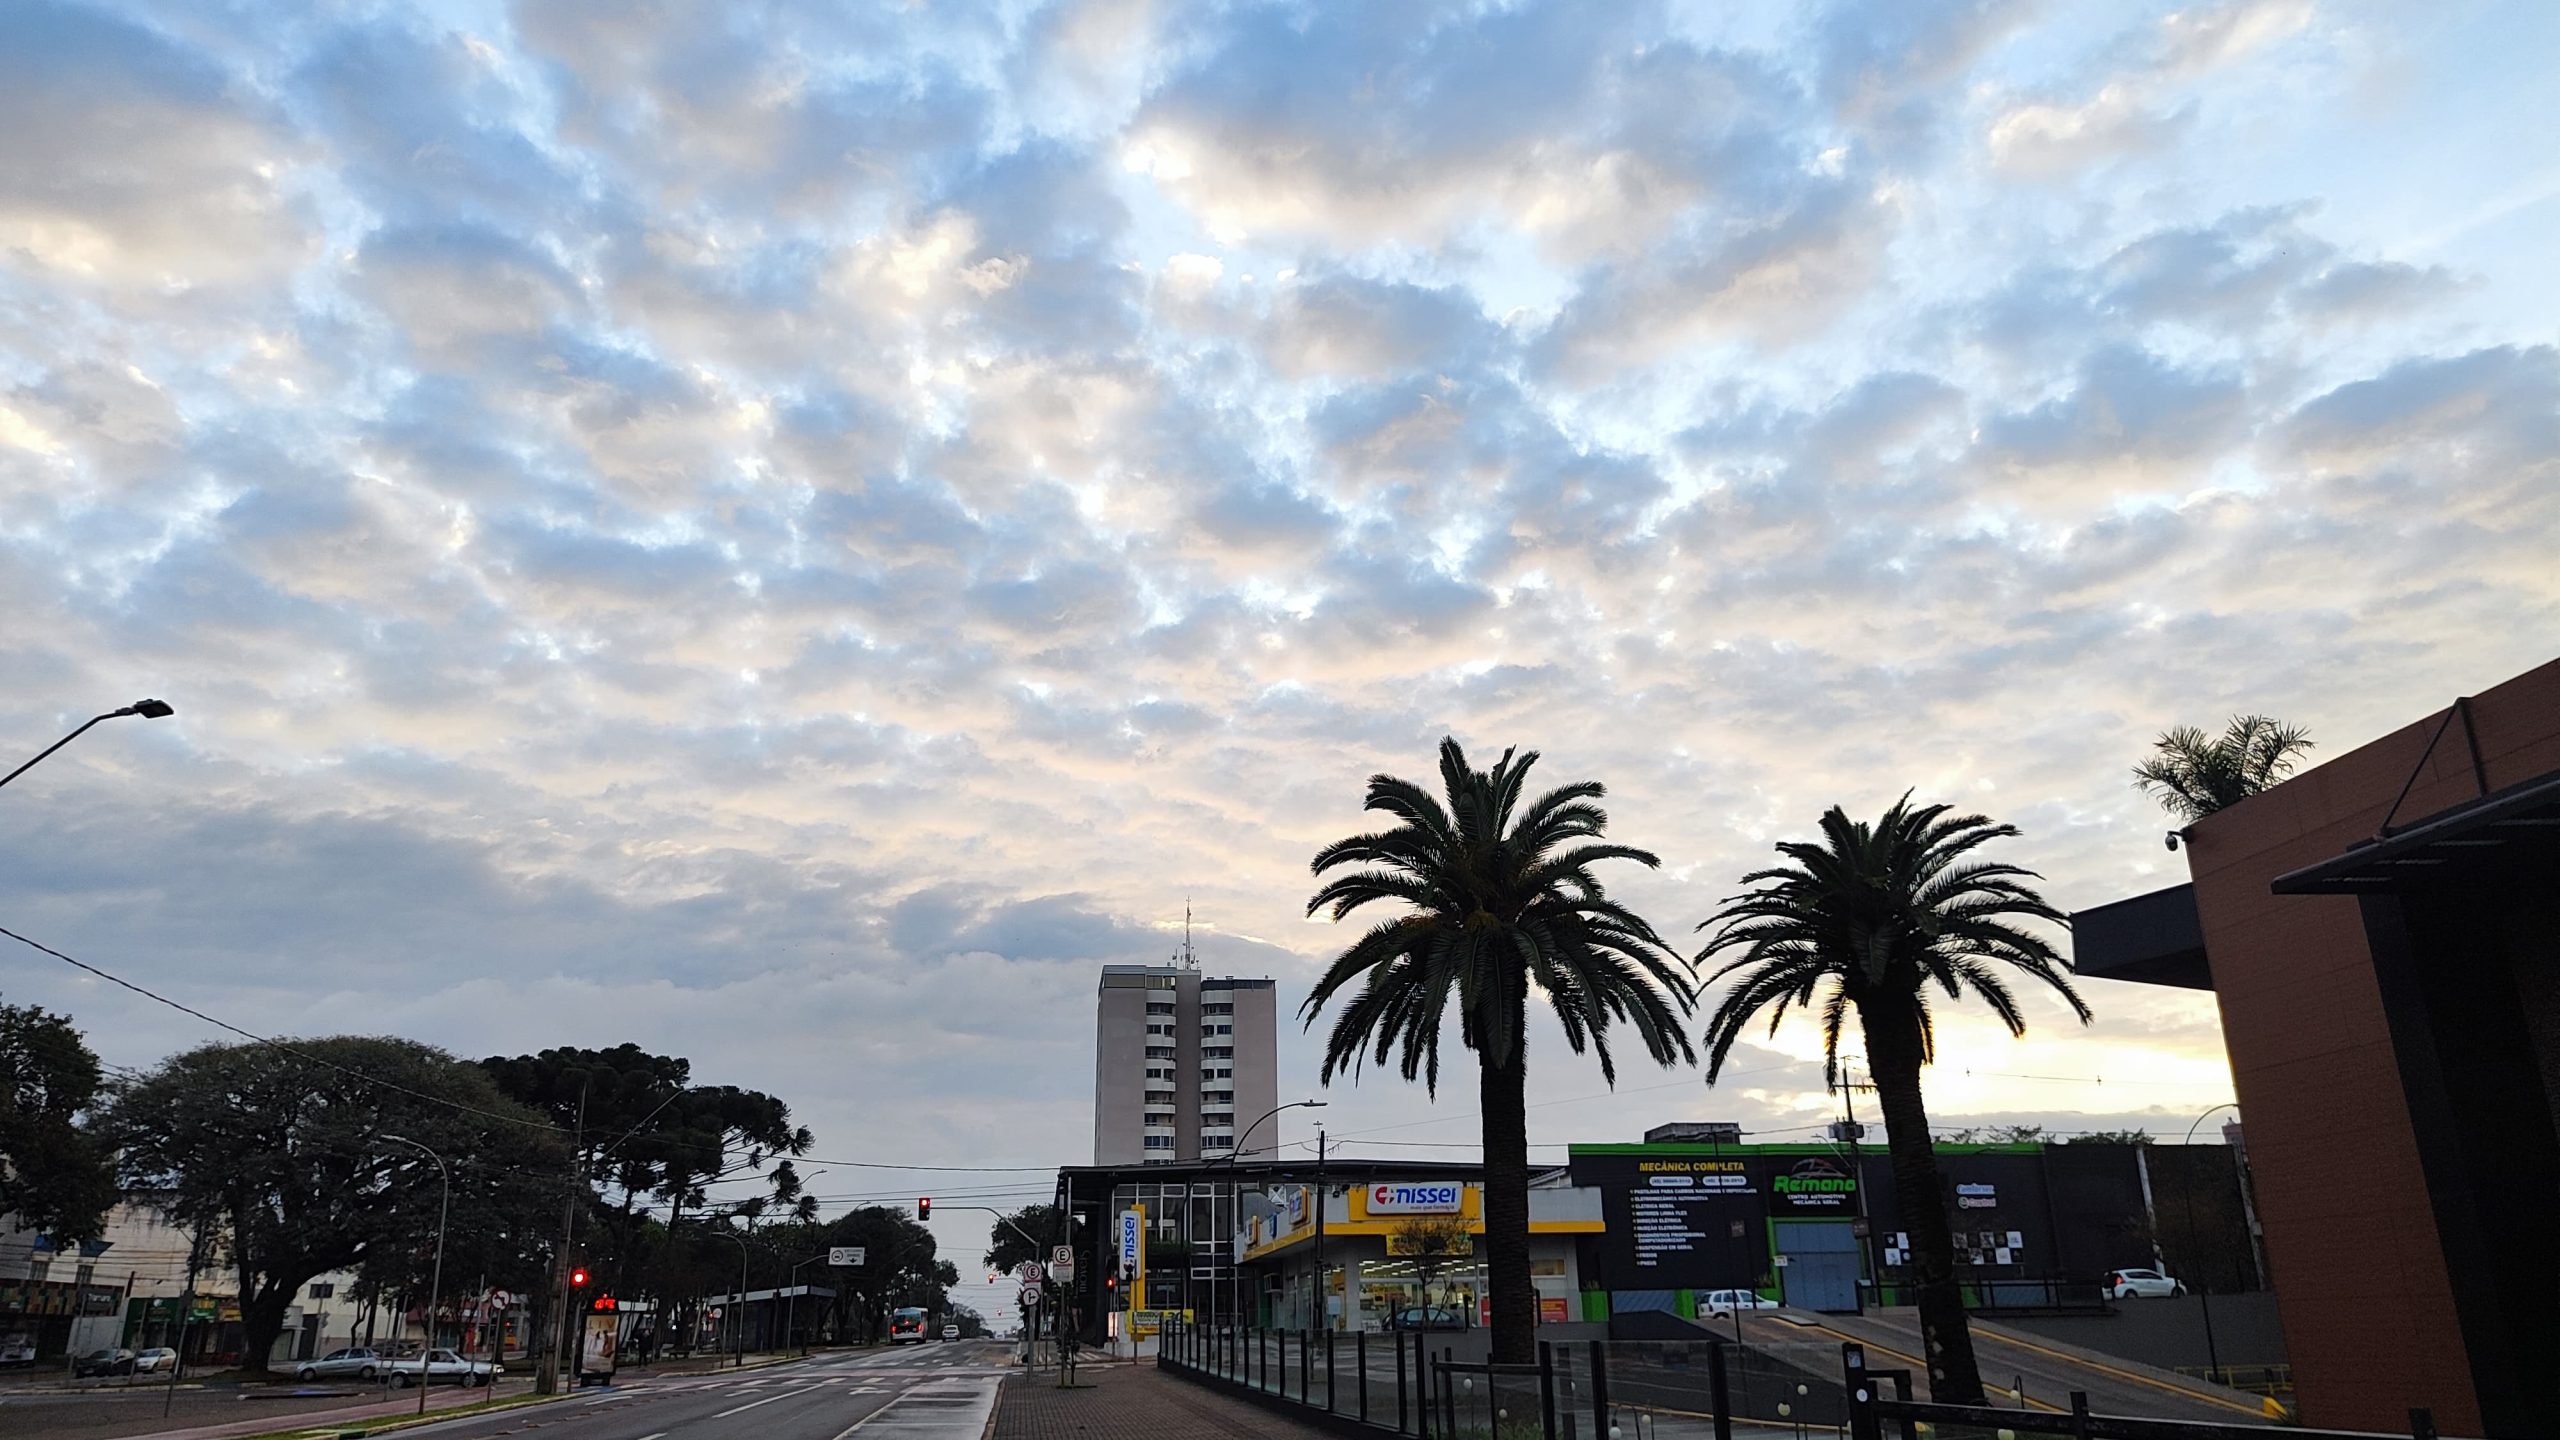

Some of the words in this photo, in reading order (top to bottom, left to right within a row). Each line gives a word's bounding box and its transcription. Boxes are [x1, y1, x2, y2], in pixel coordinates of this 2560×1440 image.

[1639, 1160, 1691, 1171] MECÂNICA
[1396, 1187, 1456, 1204] nissei
[1125, 1217, 1135, 1259] nissei
